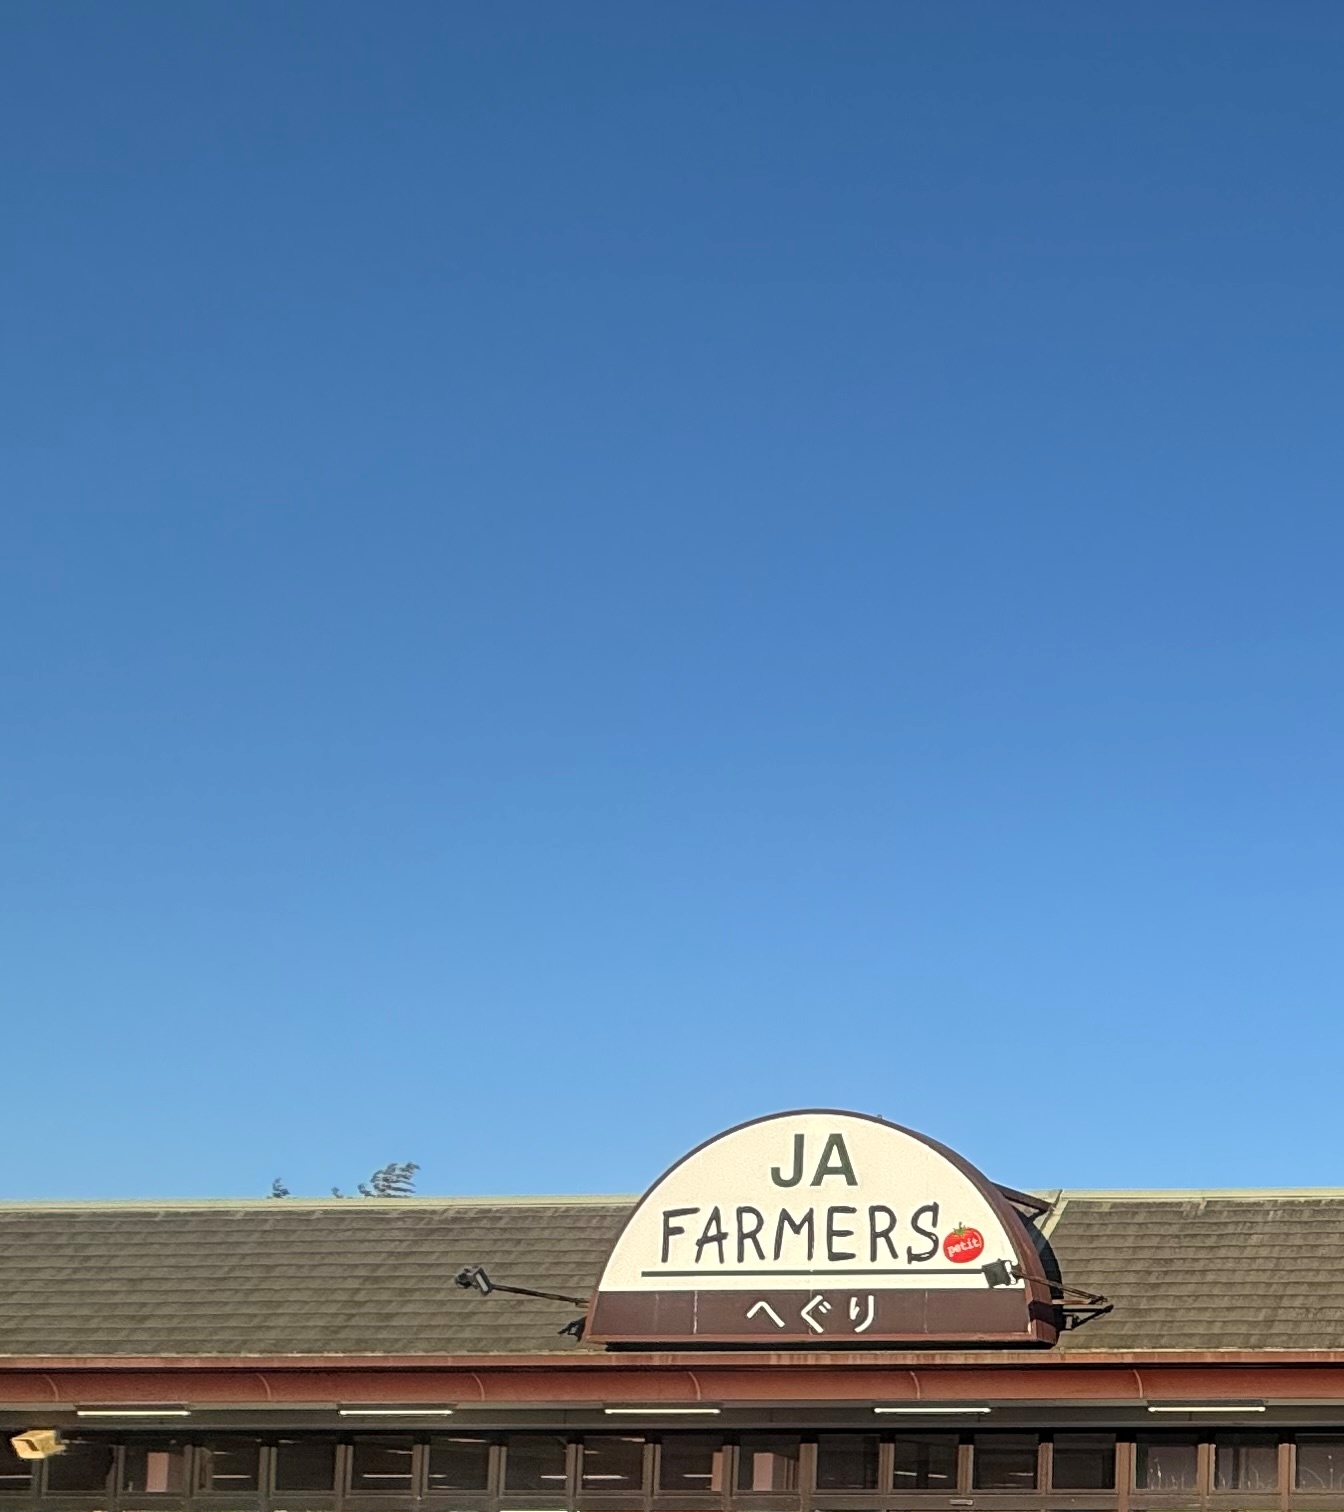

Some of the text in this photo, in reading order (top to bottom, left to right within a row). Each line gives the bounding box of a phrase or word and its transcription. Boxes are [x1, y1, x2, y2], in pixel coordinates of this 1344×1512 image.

[770, 1133, 859, 1188] JA
[661, 1202, 940, 1265] FARMERS
[946, 1237, 981, 1258] petit
[746, 1294, 875, 1334] へぐり
